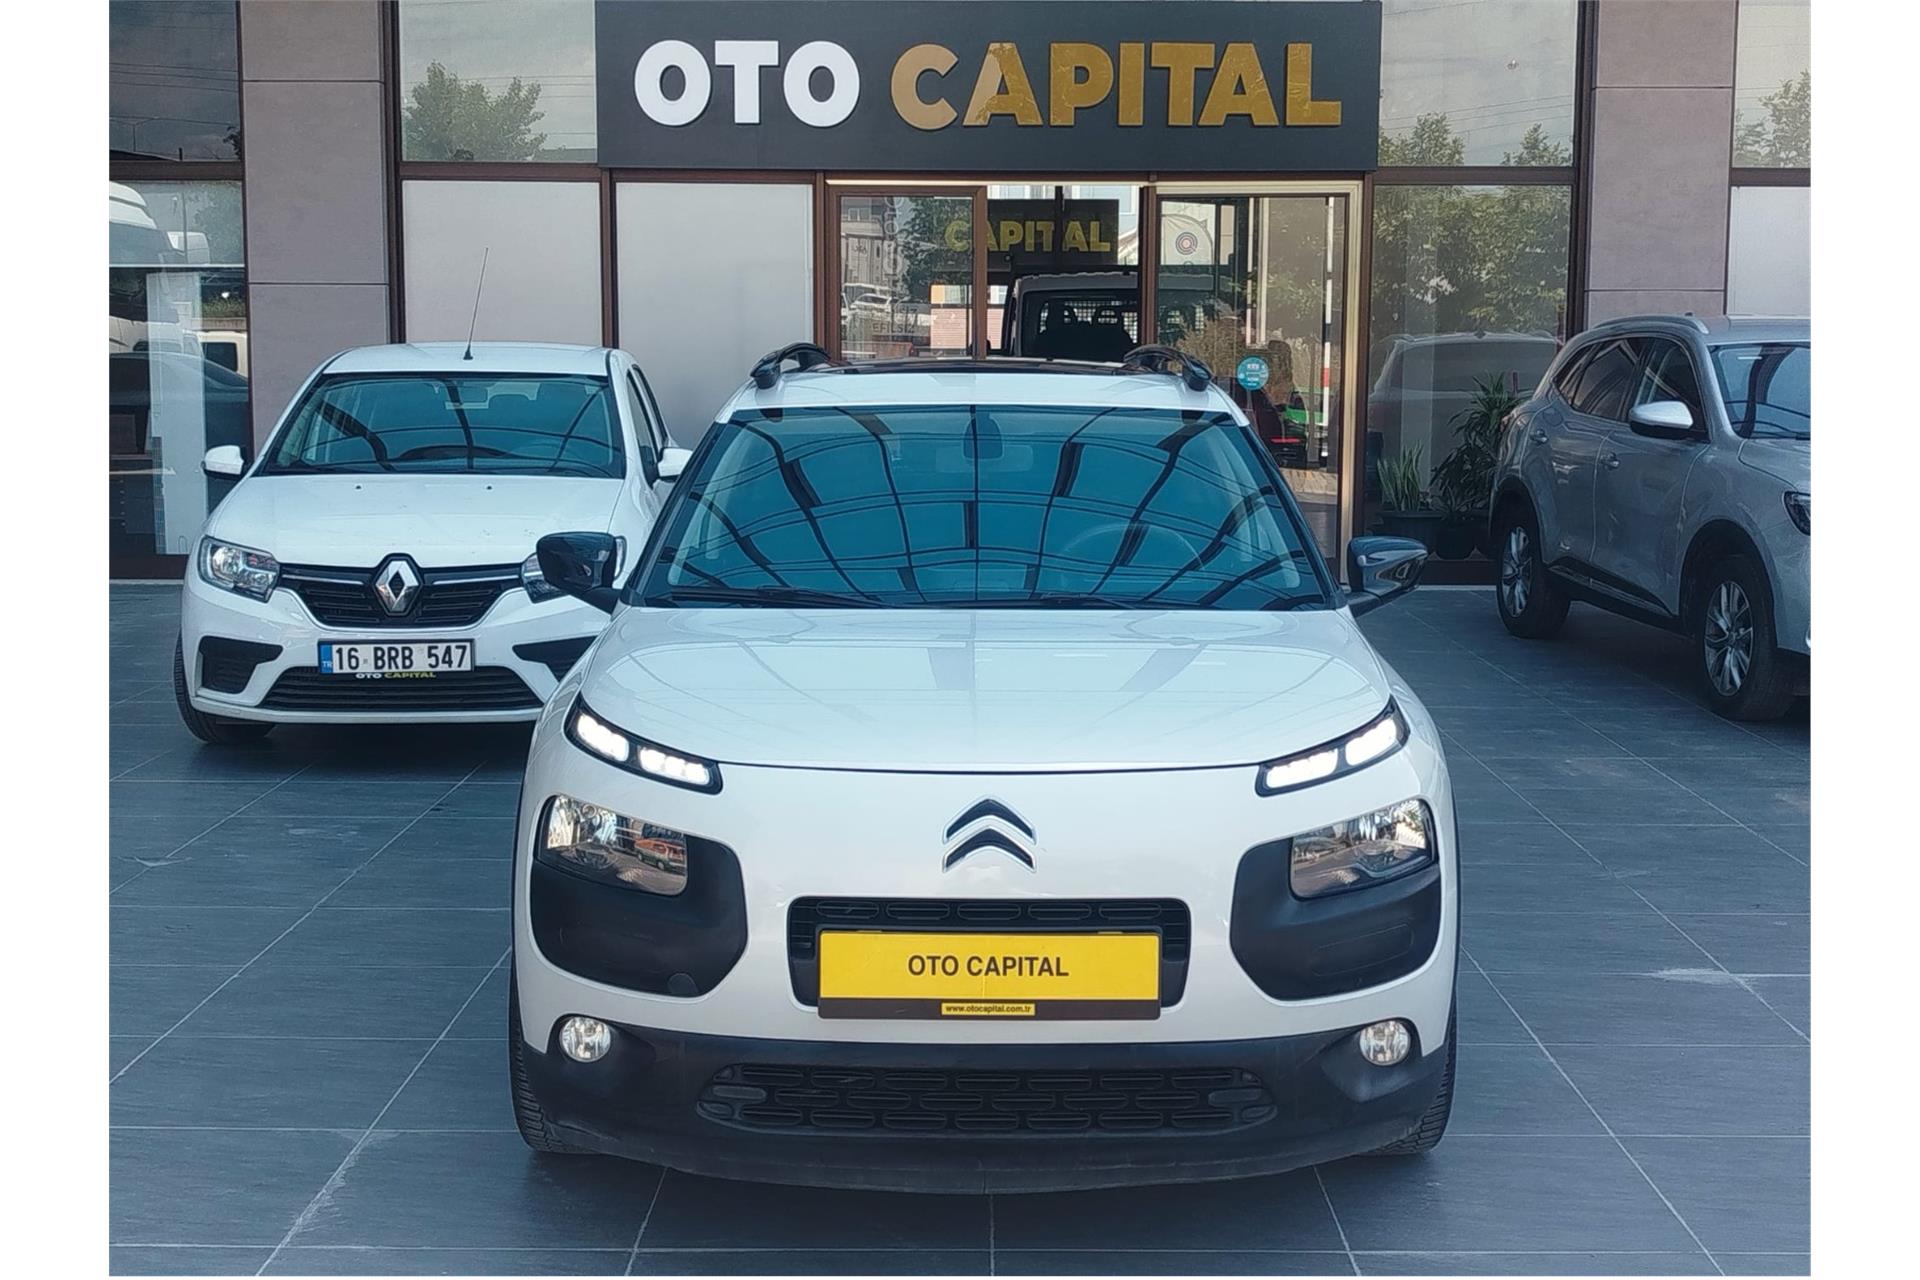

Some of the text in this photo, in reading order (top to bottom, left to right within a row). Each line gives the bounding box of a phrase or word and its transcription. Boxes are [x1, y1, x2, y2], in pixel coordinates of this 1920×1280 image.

[633, 40, 1342, 130] OTO CAPITAL
[336, 645, 467, 670] 16 BRB 547
[907, 955, 1069, 977] OTO CAPITAL
[945, 1005, 1031, 1014] www.otocapital.com.tr
